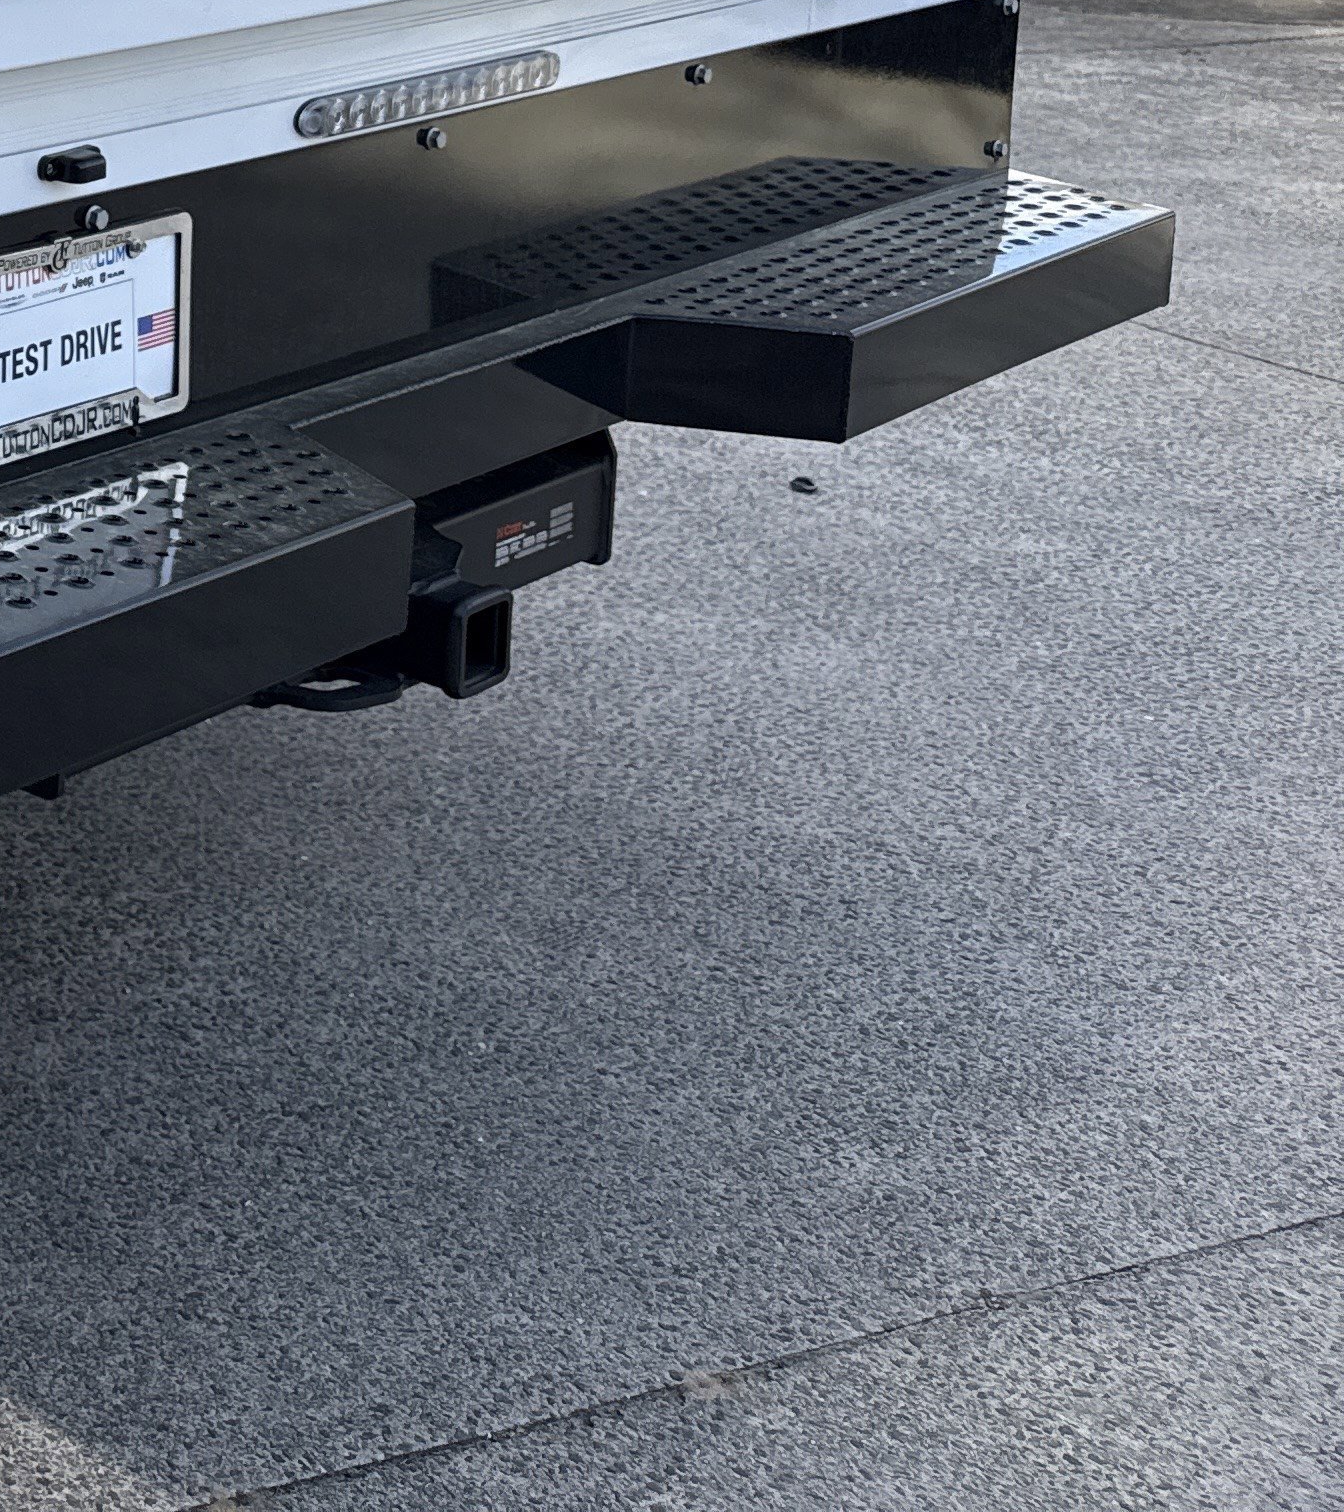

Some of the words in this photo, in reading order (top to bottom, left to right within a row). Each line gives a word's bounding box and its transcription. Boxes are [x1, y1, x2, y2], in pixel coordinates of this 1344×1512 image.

[40, 250, 51, 264] BY
[73, 239, 103, 255] TUTTON
[72, 275, 94, 290] Jeep
[60, 318, 123, 368] DRIVE
